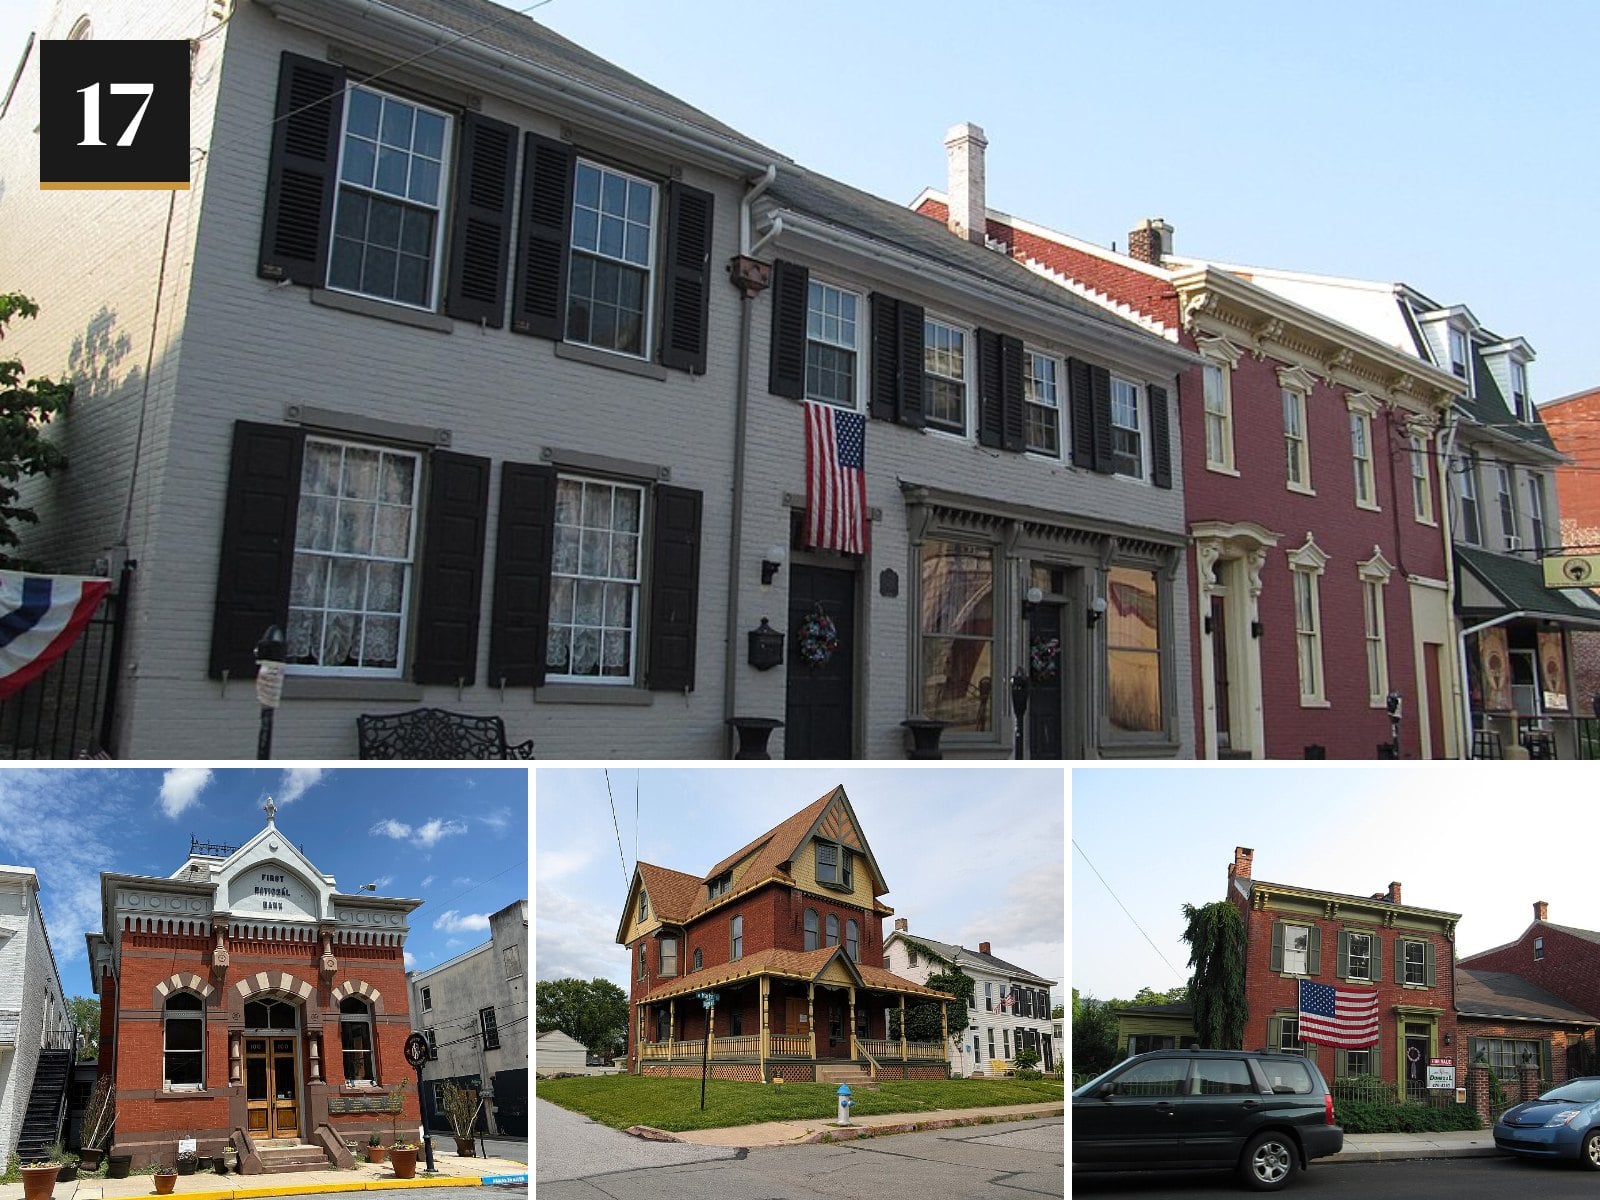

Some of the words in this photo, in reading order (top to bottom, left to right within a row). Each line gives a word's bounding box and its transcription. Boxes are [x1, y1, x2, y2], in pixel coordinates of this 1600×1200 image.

[262, 874, 284, 882] FIRST
[254, 886, 291, 896] NATIONAL
[262, 901, 283, 911] BANK
